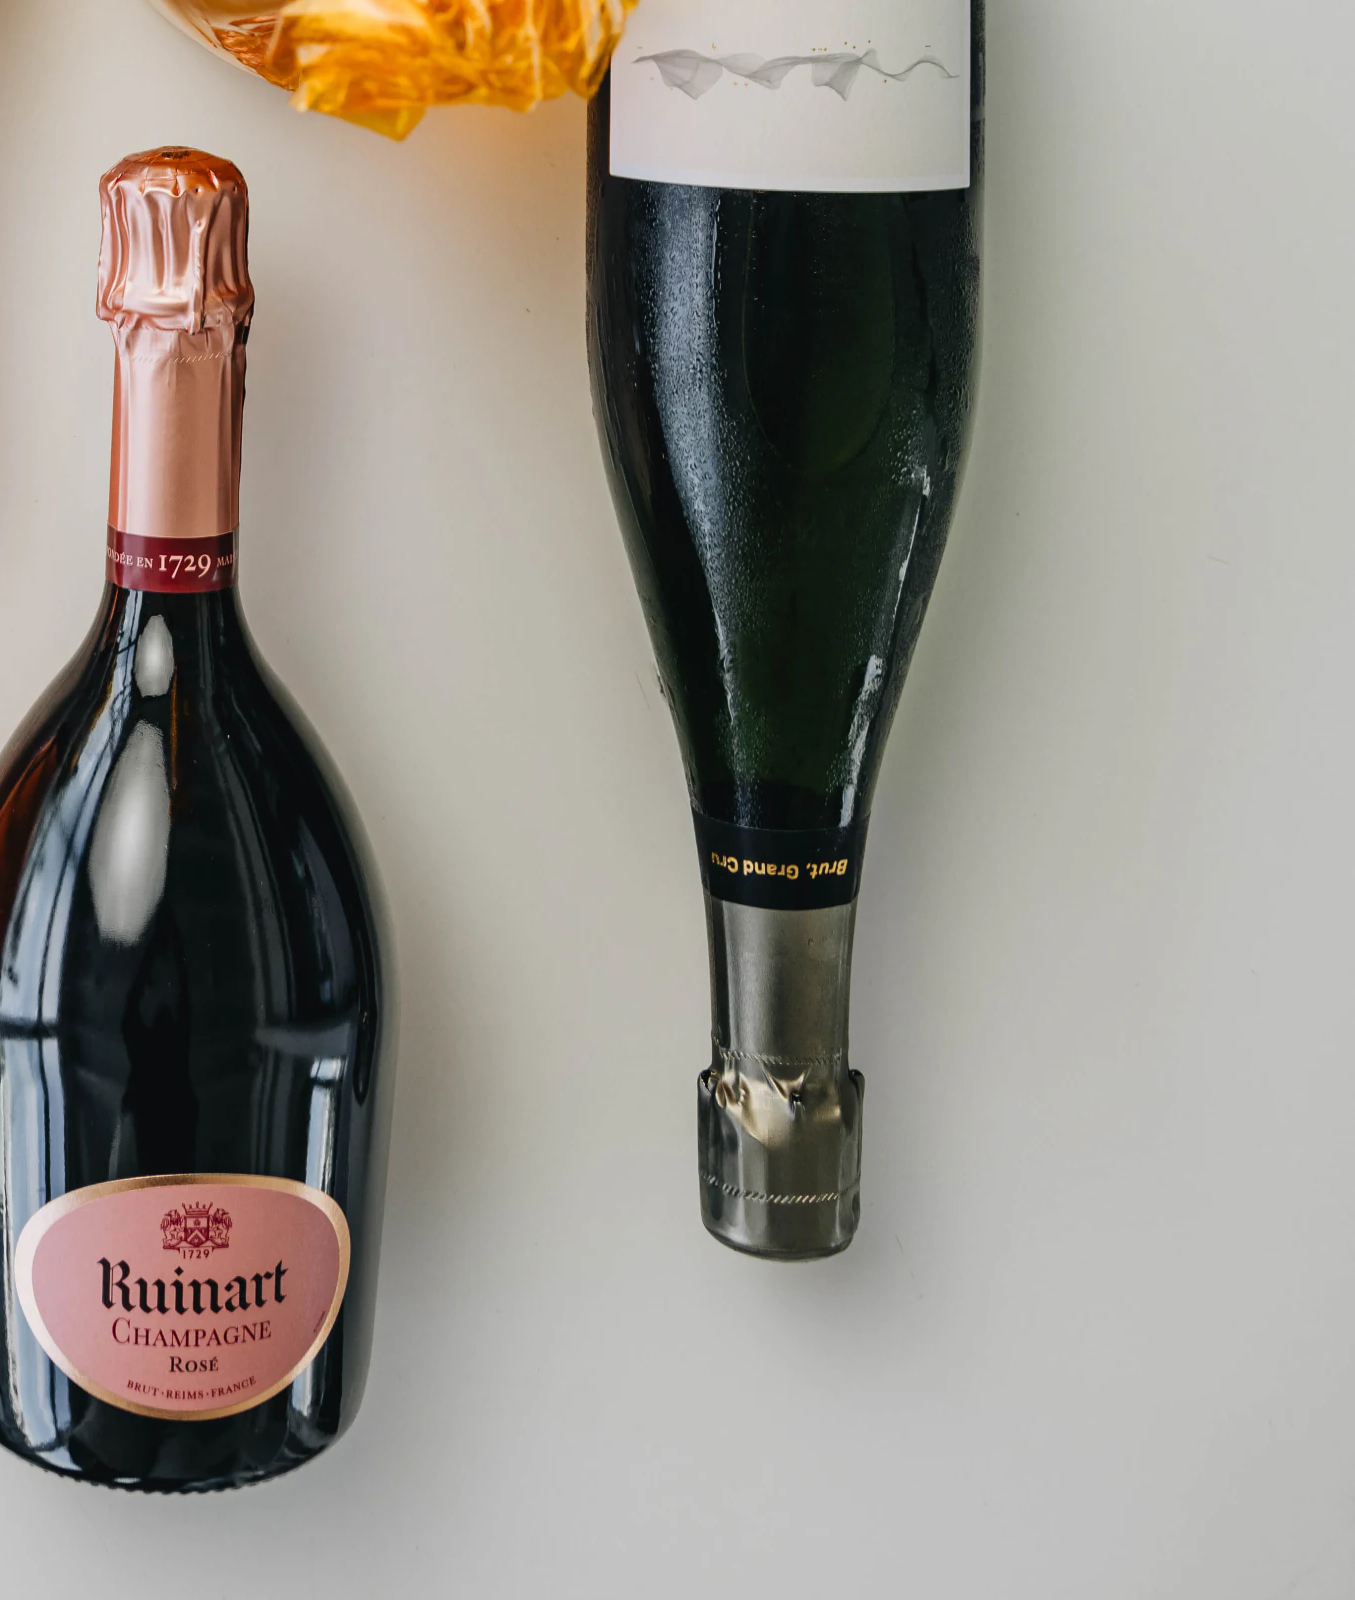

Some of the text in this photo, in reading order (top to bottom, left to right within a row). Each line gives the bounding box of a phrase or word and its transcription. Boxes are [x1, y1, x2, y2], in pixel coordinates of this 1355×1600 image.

[137, 557, 154, 569] EN
[158, 553, 212, 579] 1729
[711, 851, 849, 880] Brut, Grand Cru
[181, 1249, 211, 1259] 1729
[96, 1256, 289, 1316] Ruinart
[111, 1317, 272, 1348] CHAMPAGNE
[127, 1375, 257, 1400] BRUT REIMS FRANCE
